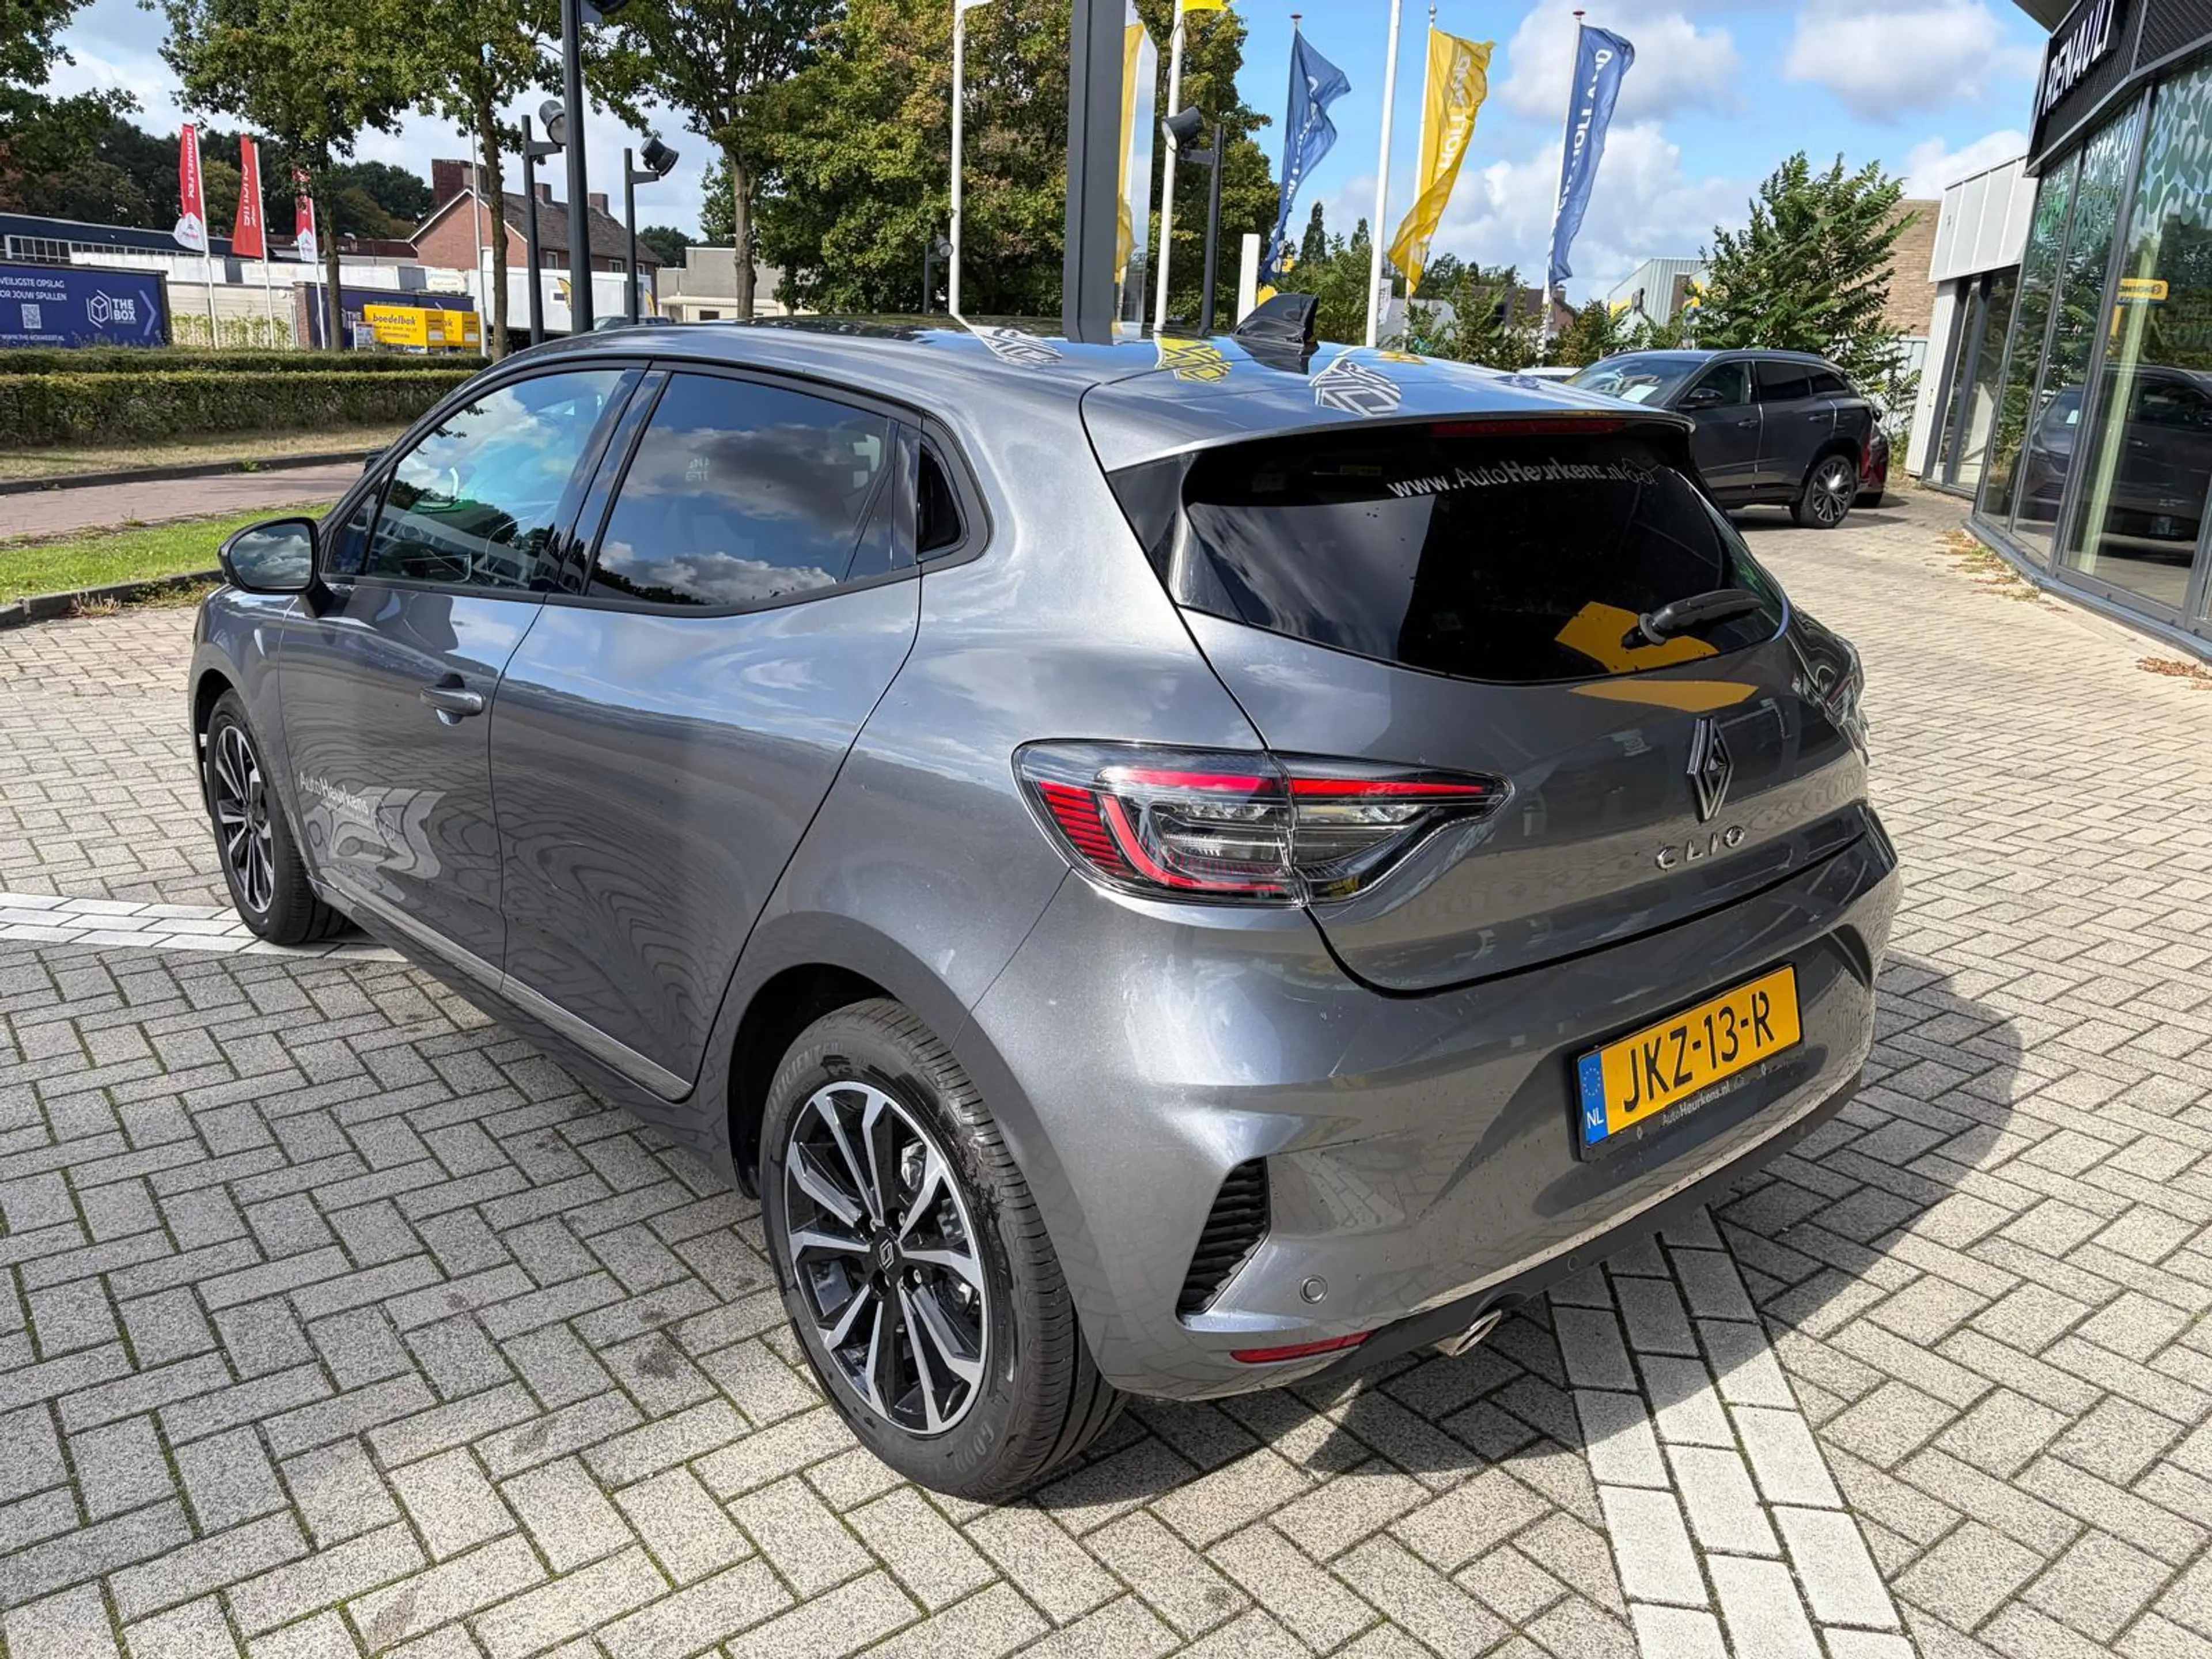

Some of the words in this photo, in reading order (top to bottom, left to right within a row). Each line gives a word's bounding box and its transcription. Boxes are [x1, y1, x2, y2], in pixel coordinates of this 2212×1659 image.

[36, 279, 65, 288] OPSLAG
[12, 290, 35, 300] JOUW
[35, 291, 67, 301] SPULLEN
[112, 298, 134, 309] THE
[113, 309, 136, 321] BOX
[373, 312, 416, 326] boedelbak
[1656, 825, 1745, 871] CLIO
[1623, 990, 1775, 1113] JKZ-13-R
[1662, 1080, 1730, 1126] AutoHeurkens.nl
[1586, 1107, 1604, 1130] NL
